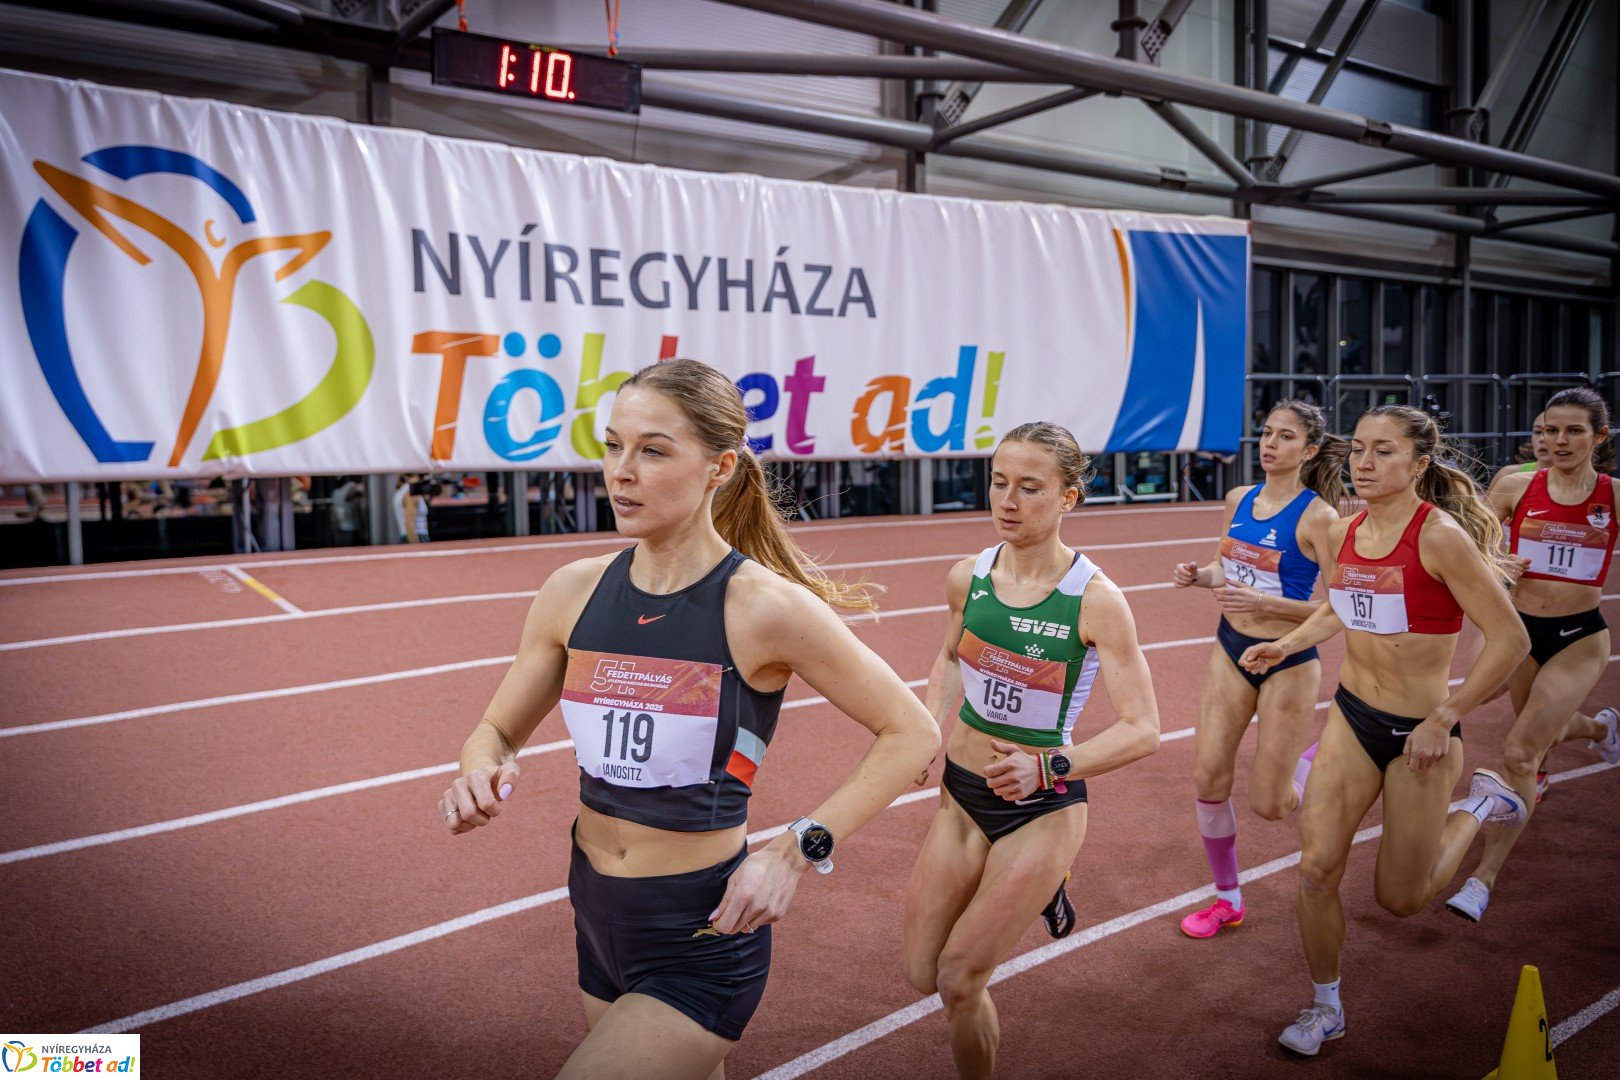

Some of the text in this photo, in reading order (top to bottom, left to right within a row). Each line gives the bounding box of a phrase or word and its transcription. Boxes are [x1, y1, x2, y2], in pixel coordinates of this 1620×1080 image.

[412, 224, 877, 319] NYÍREGYHÁZA
[411, 329, 1006, 462] Töbet ad!
[1548, 545, 1575, 568] 111
[1350, 593, 1373, 619] 157
[606, 669, 673, 685] FEDETTPÁLYÁS
[593, 696, 664, 712] NYÍREGYHÁZA 2025
[983, 678, 1023, 714] 155
[986, 709, 1008, 722] VARGA
[602, 709, 655, 763] 119
